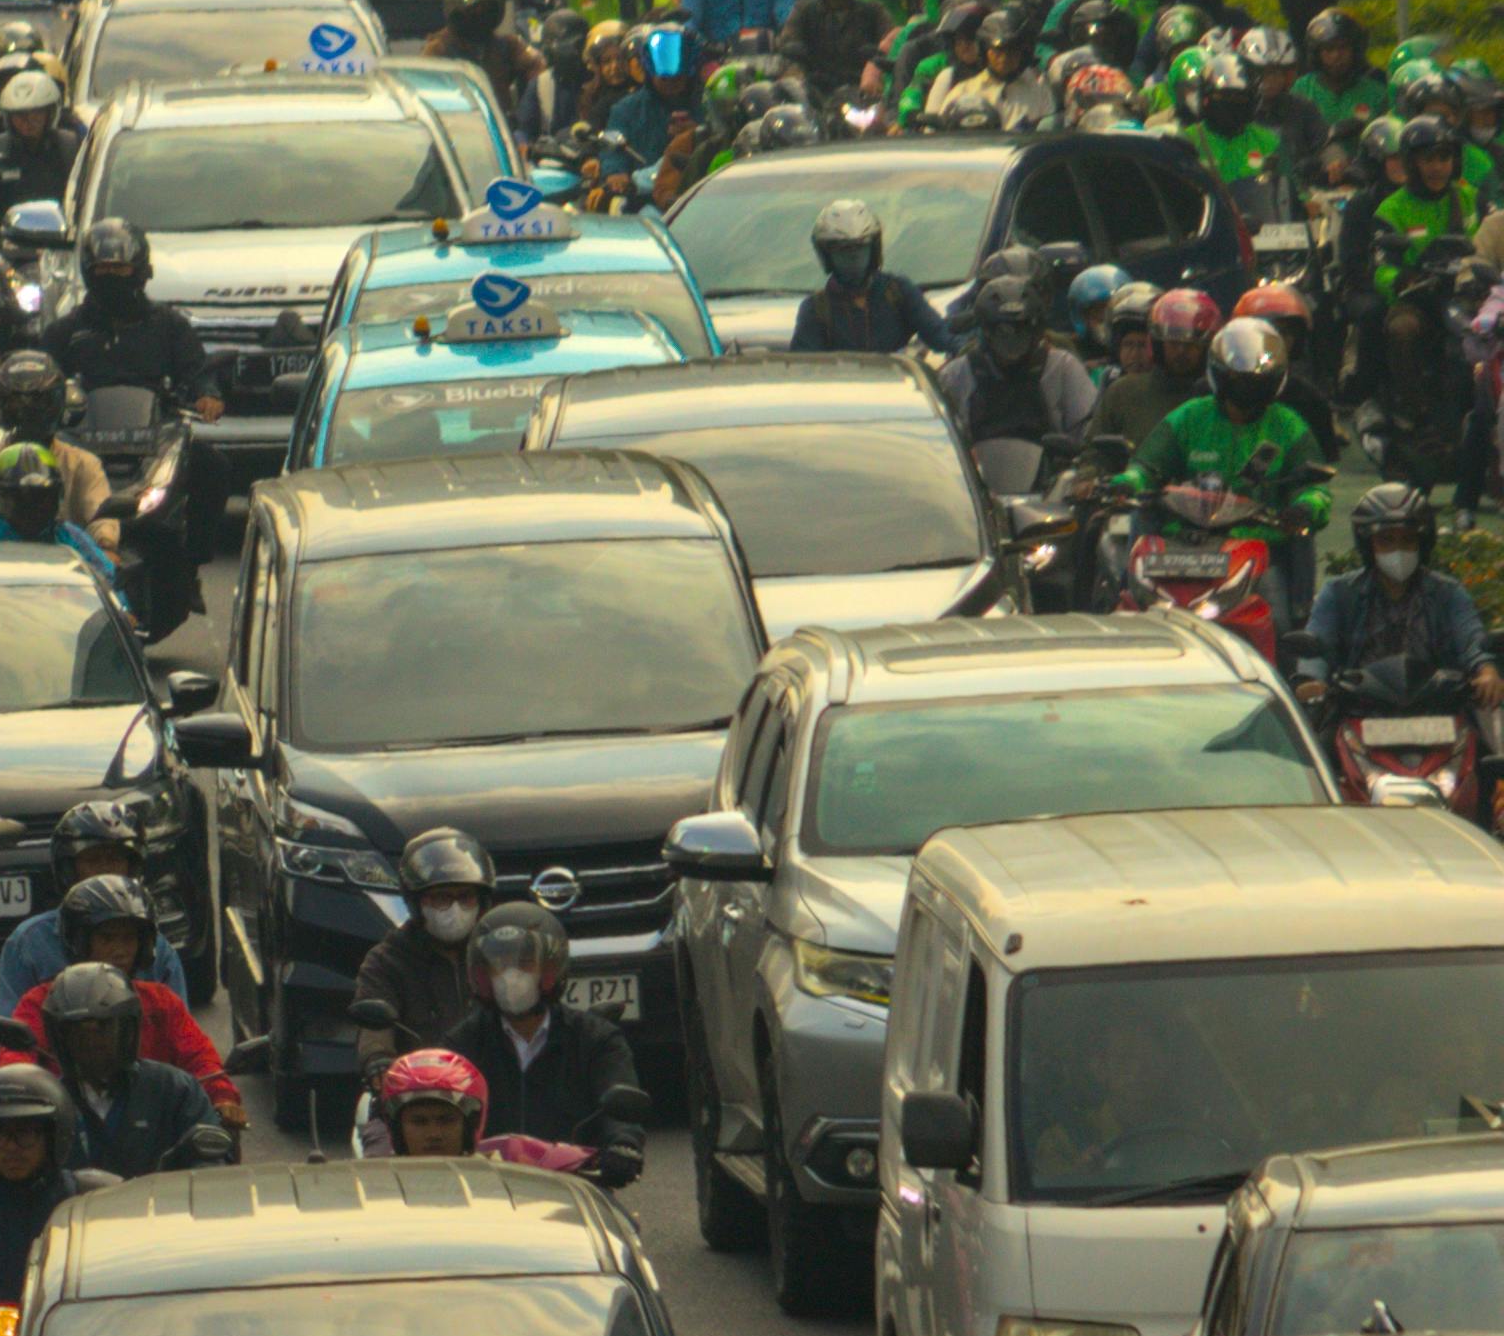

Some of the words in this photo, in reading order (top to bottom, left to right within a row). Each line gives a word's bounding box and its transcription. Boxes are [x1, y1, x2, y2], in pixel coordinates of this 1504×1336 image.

[302, 61, 365, 74] TAKSI
[481, 220, 553, 239] TAKSI
[204, 286, 288, 298] PAJERO
[465, 317, 543, 337] TAKSI
